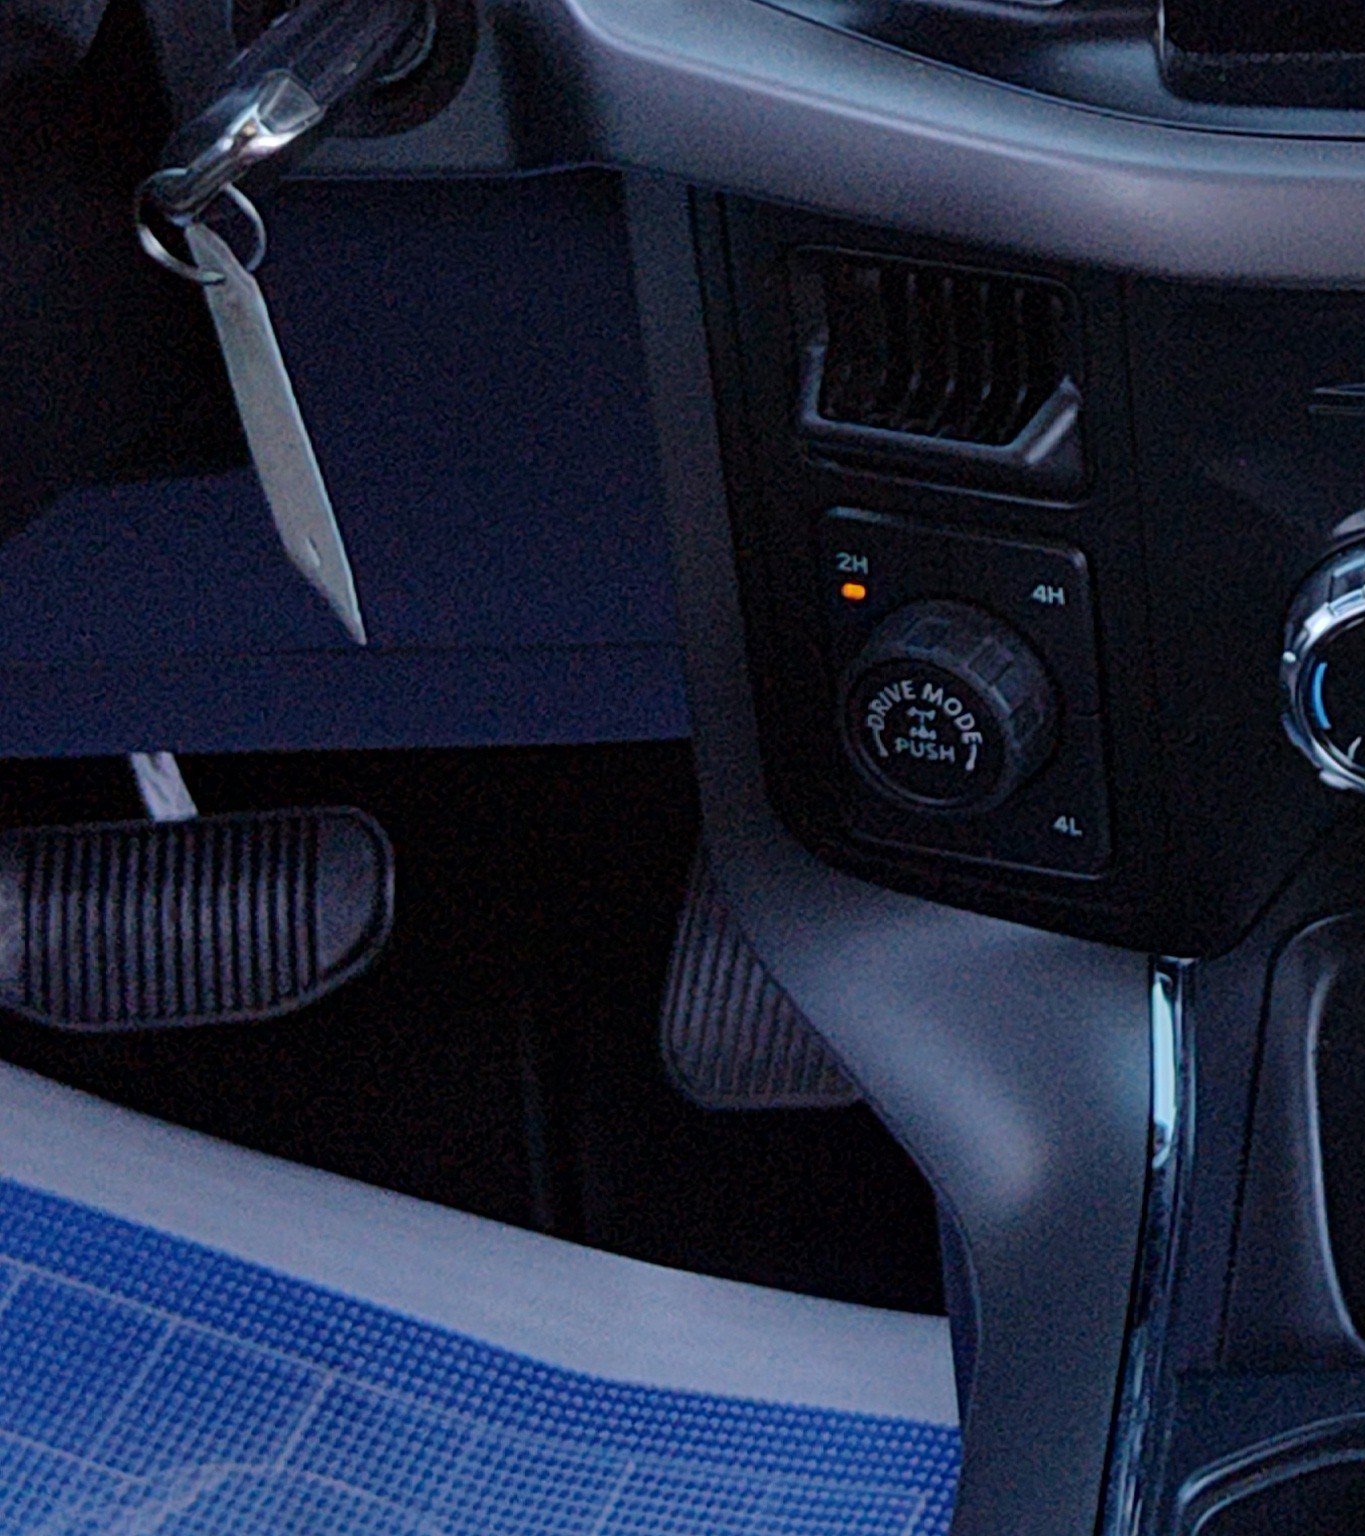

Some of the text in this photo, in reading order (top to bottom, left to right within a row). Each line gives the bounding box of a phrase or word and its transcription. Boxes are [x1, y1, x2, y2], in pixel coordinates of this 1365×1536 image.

[836, 551, 869, 575] 2H
[1031, 584, 1067, 606] 4H
[867, 679, 984, 746] DRIVE MODE
[895, 737, 956, 763] PUSH
[1053, 815, 1084, 837] 4L
